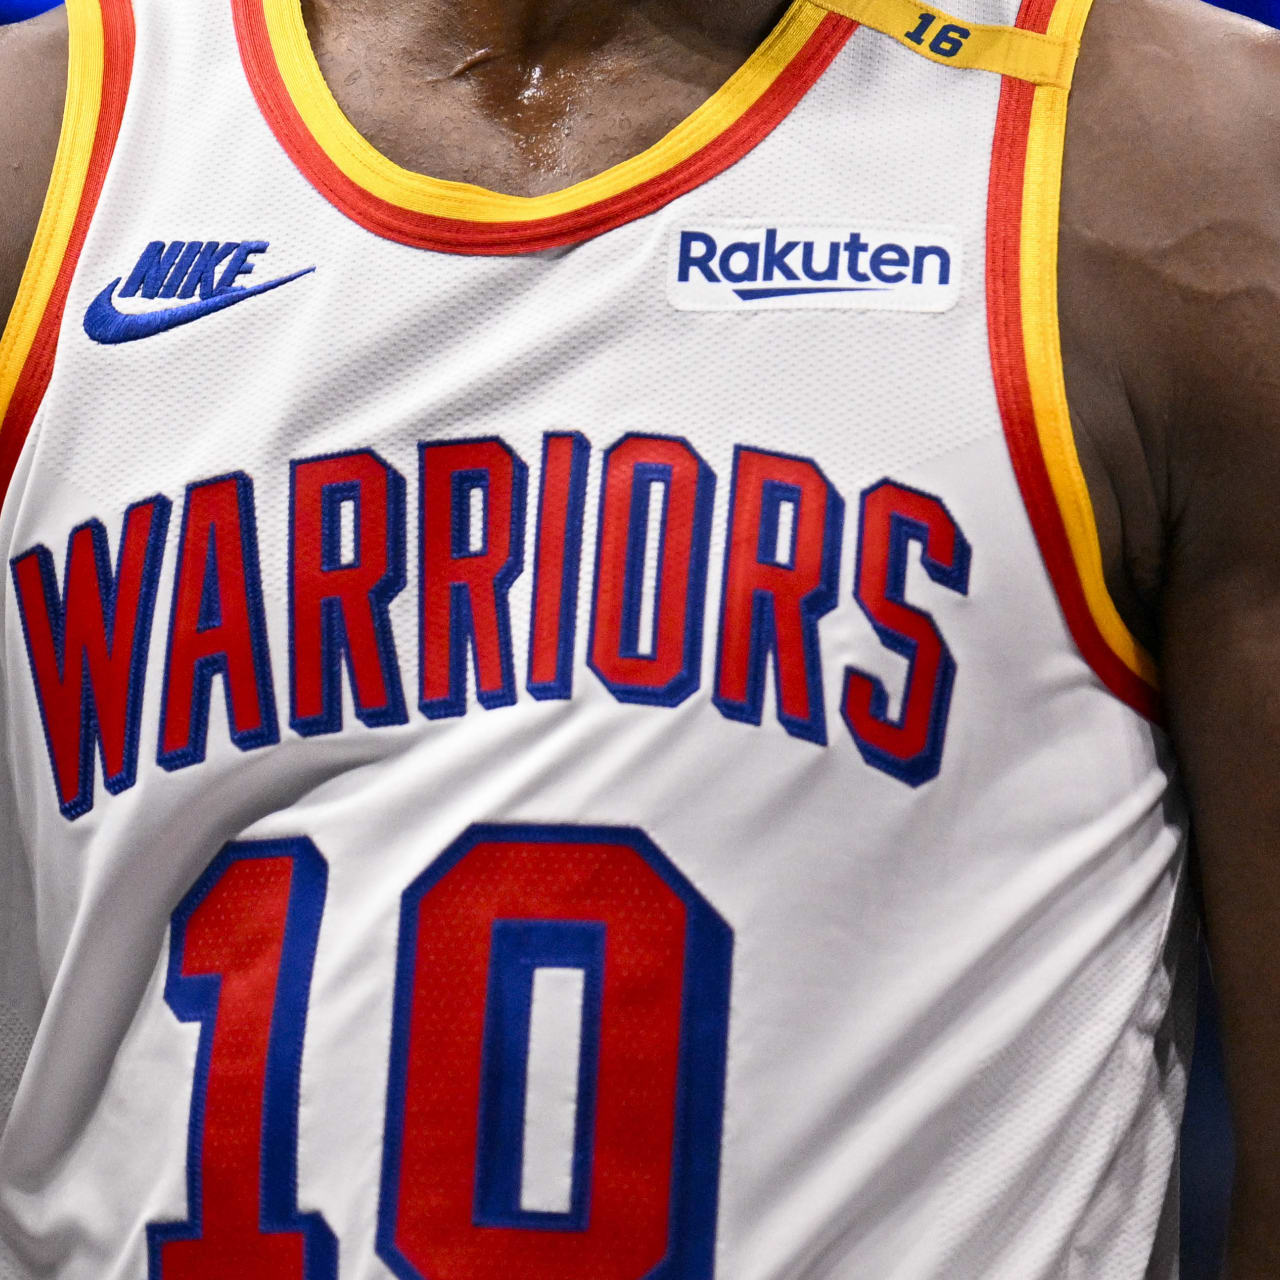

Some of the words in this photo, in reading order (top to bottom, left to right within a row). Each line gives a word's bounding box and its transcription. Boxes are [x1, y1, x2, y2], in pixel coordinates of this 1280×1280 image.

[904, 12, 970, 58] 16
[117, 240, 270, 301] NIKE
[677, 227, 951, 285] Rakuten
[9, 430, 970, 822] WARRIORS
[145, 821, 735, 1280] 10
